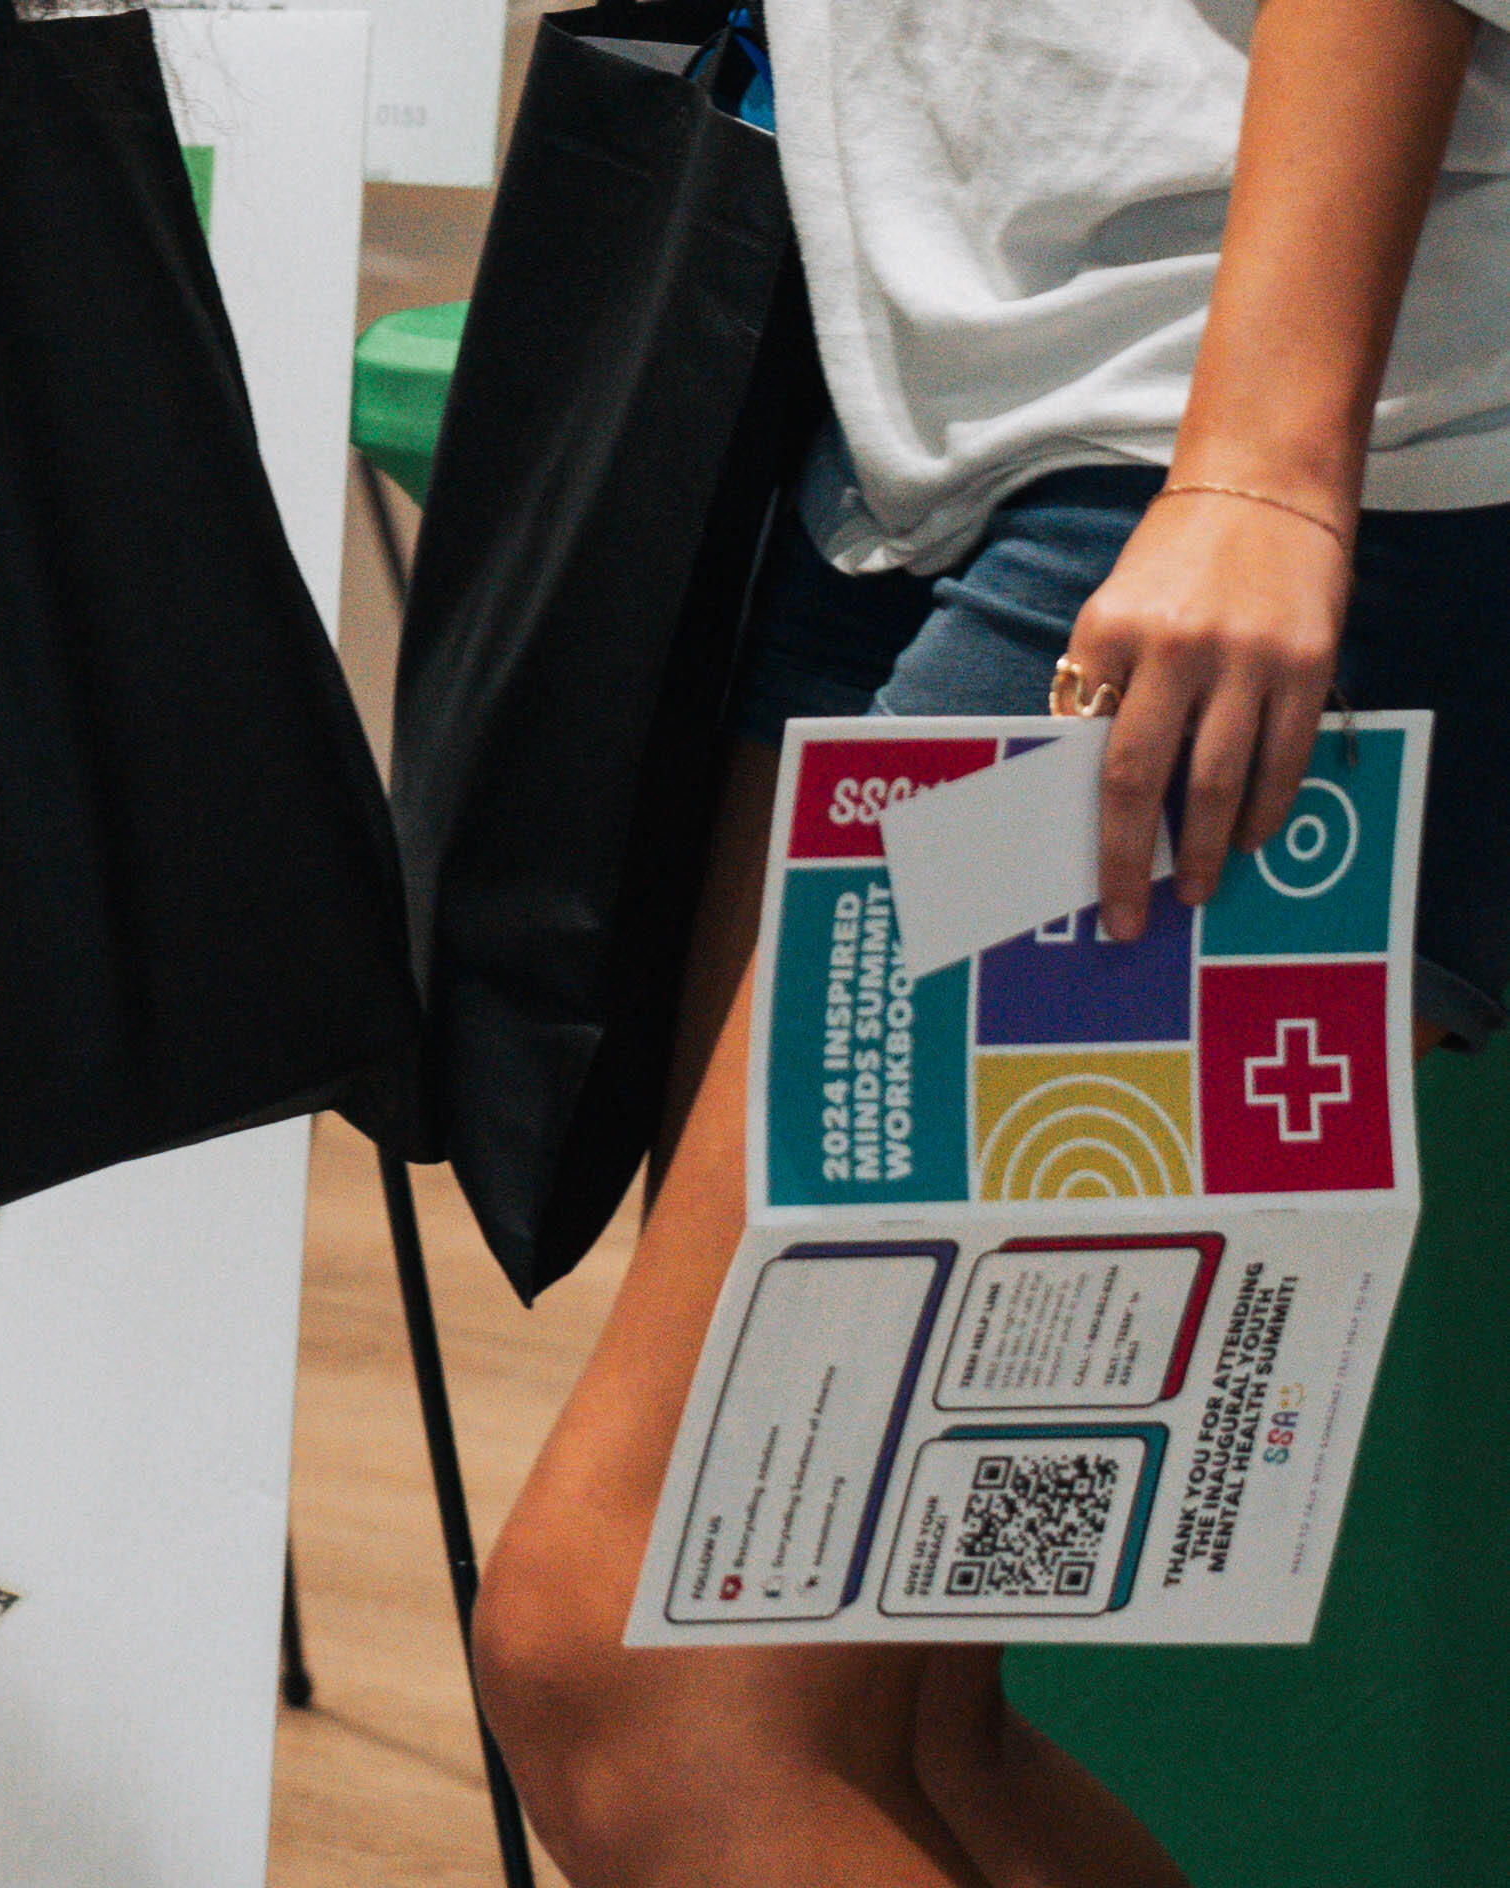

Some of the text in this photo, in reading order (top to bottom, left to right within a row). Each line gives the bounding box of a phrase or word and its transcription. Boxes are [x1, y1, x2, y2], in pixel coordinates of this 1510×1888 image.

[821, 891, 861, 1182] 2024 INSPIRED
[853, 882, 891, 1181] MINDS SUMMIT
[1162, 1262, 1264, 1589] THANK YOU FOR ATTENDING
[1189, 1287, 1276, 1560] THE INAUGURAL YOUTH
[1207, 1275, 1299, 1574] MENTAL HEALTH SUMMIT!
[1262, 1410, 1299, 1466] SSA
